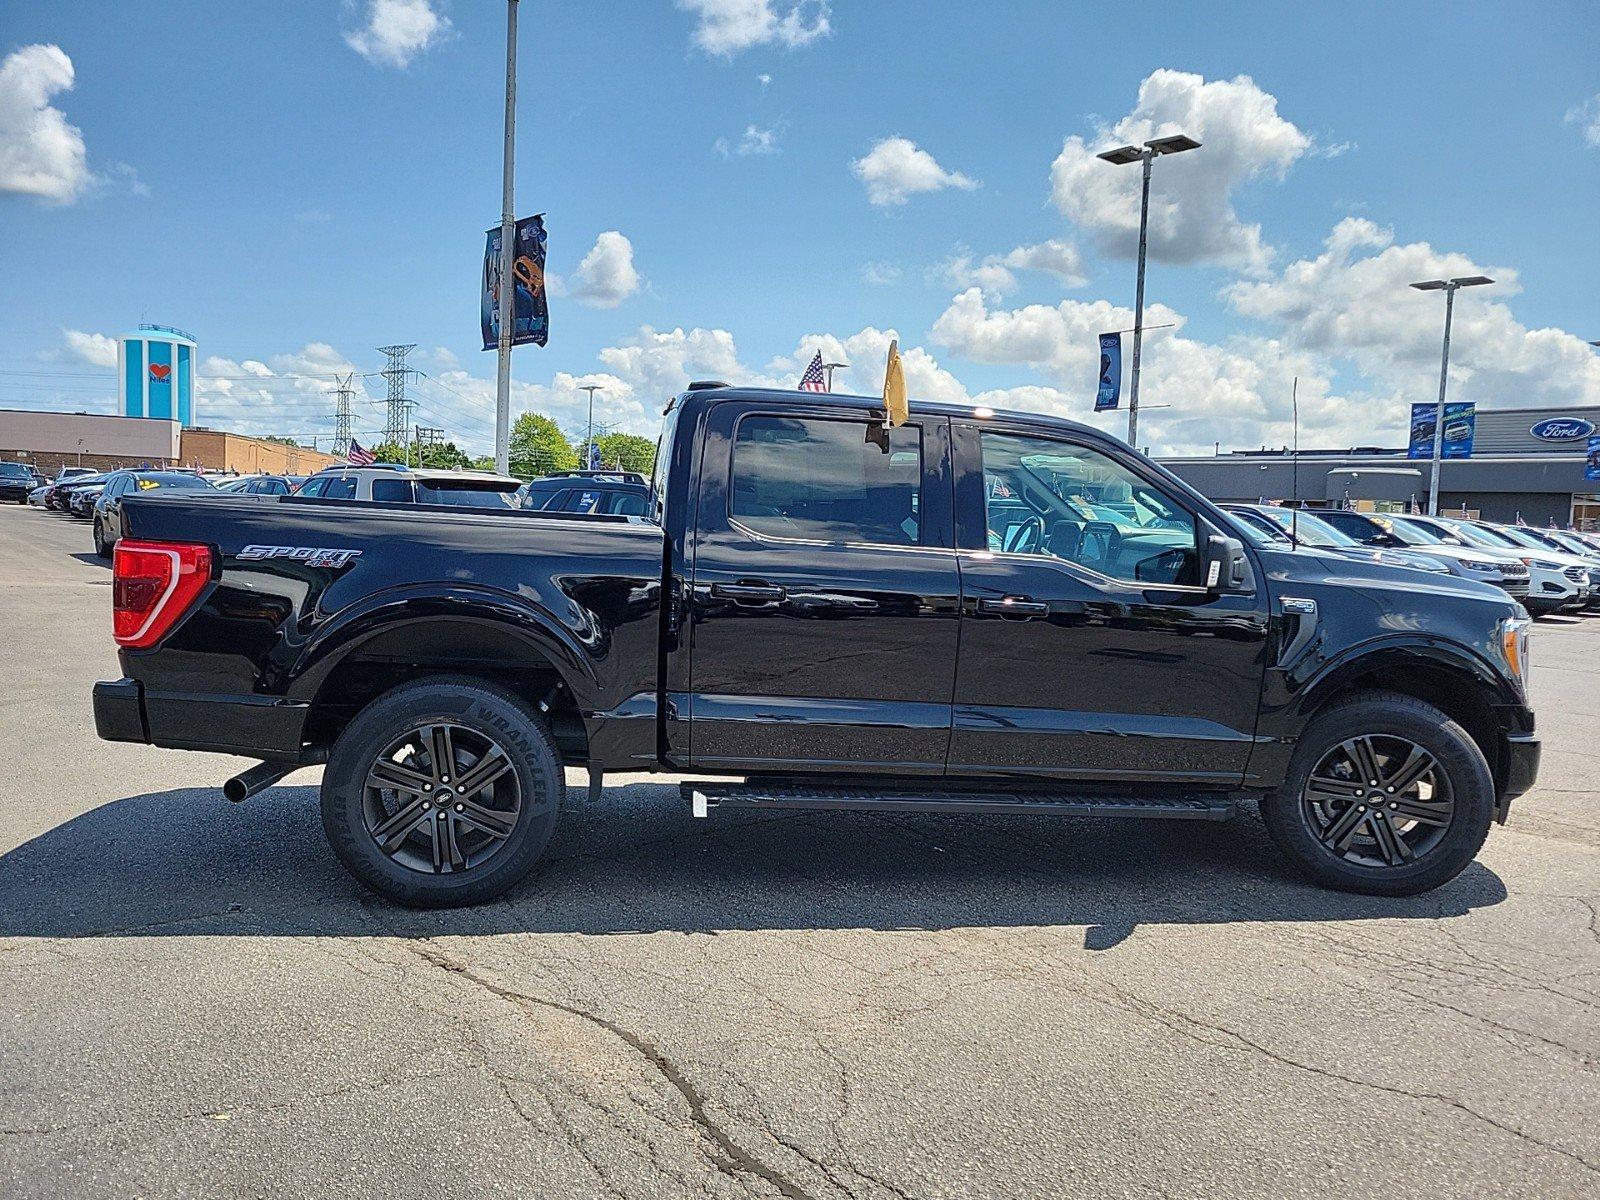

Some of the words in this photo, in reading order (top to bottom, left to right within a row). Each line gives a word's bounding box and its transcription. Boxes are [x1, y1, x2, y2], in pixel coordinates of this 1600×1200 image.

[149, 376, 171, 384] Niles
[1542, 423, 1580, 437] Ford
[236, 544, 363, 561] SPORT
[479, 706, 547, 804] WRANGLER
